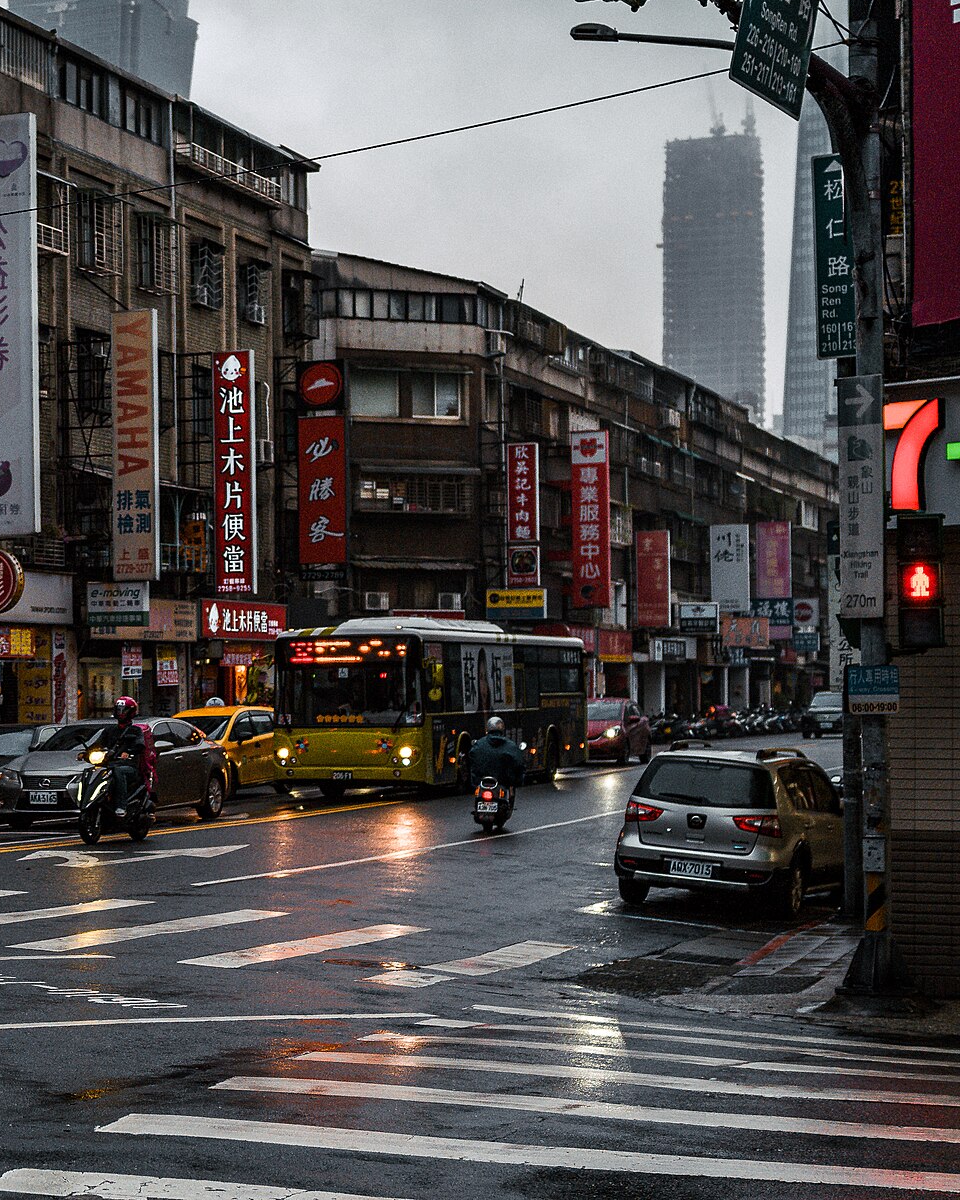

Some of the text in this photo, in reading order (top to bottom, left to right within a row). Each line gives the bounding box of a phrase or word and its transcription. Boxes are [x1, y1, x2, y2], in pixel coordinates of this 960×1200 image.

[821, 284, 848, 295] Song
[821, 296, 841, 307] Ren
[821, 308, 839, 319] Rd.
[821, 322, 838, 334] 160
[821, 339, 838, 352] 210
[116, 317, 150, 477] YAMAHA
[219, 386, 246, 574] 池上木片便當
[305, 436, 344, 544] 必勝客
[117, 490, 151, 511] 排氣
[117, 513, 151, 535] 檢測
[579, 467, 601, 580] 專業服務中心
[850, 560, 872, 570] Hiking
[853, 570, 869, 579] Trail
[846, 594, 877, 608] 270m
[222, 608, 268, 633] 池上木片便當
